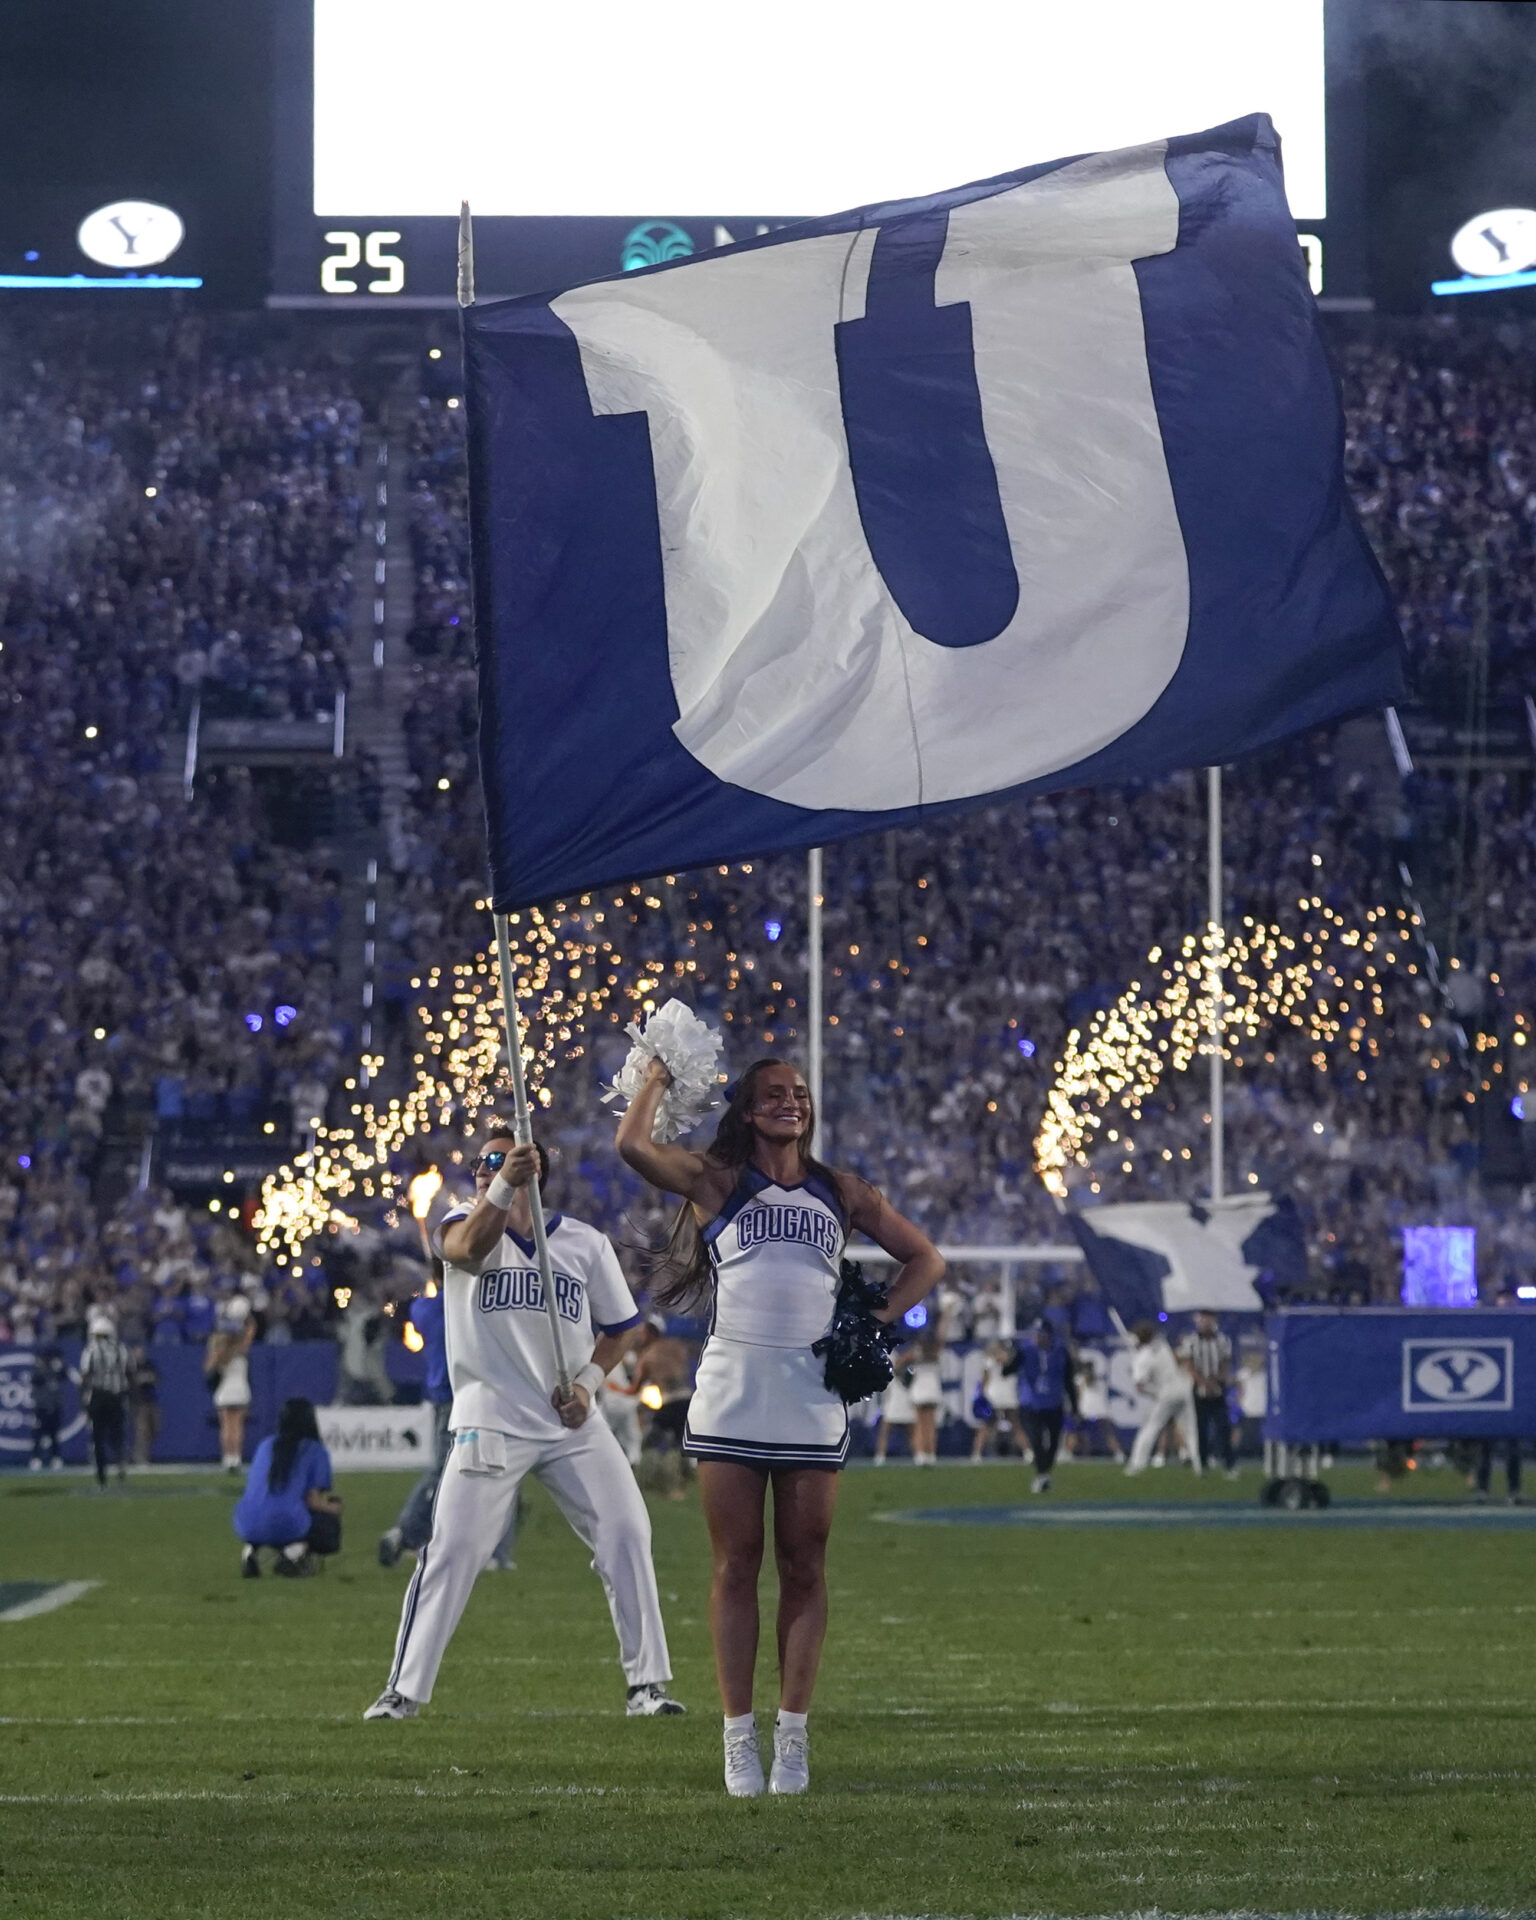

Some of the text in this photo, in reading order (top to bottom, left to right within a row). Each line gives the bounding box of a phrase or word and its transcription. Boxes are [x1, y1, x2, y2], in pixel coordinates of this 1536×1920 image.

[108, 215, 154, 255] Y
[321, 231, 404, 293] 25
[548, 138, 1192, 813] U
[737, 1205, 838, 1259] COUGARS
[1080, 1191, 1278, 1313] Y
[479, 1267, 584, 1323] COUGRS
[1432, 1357, 1484, 1394] Y
